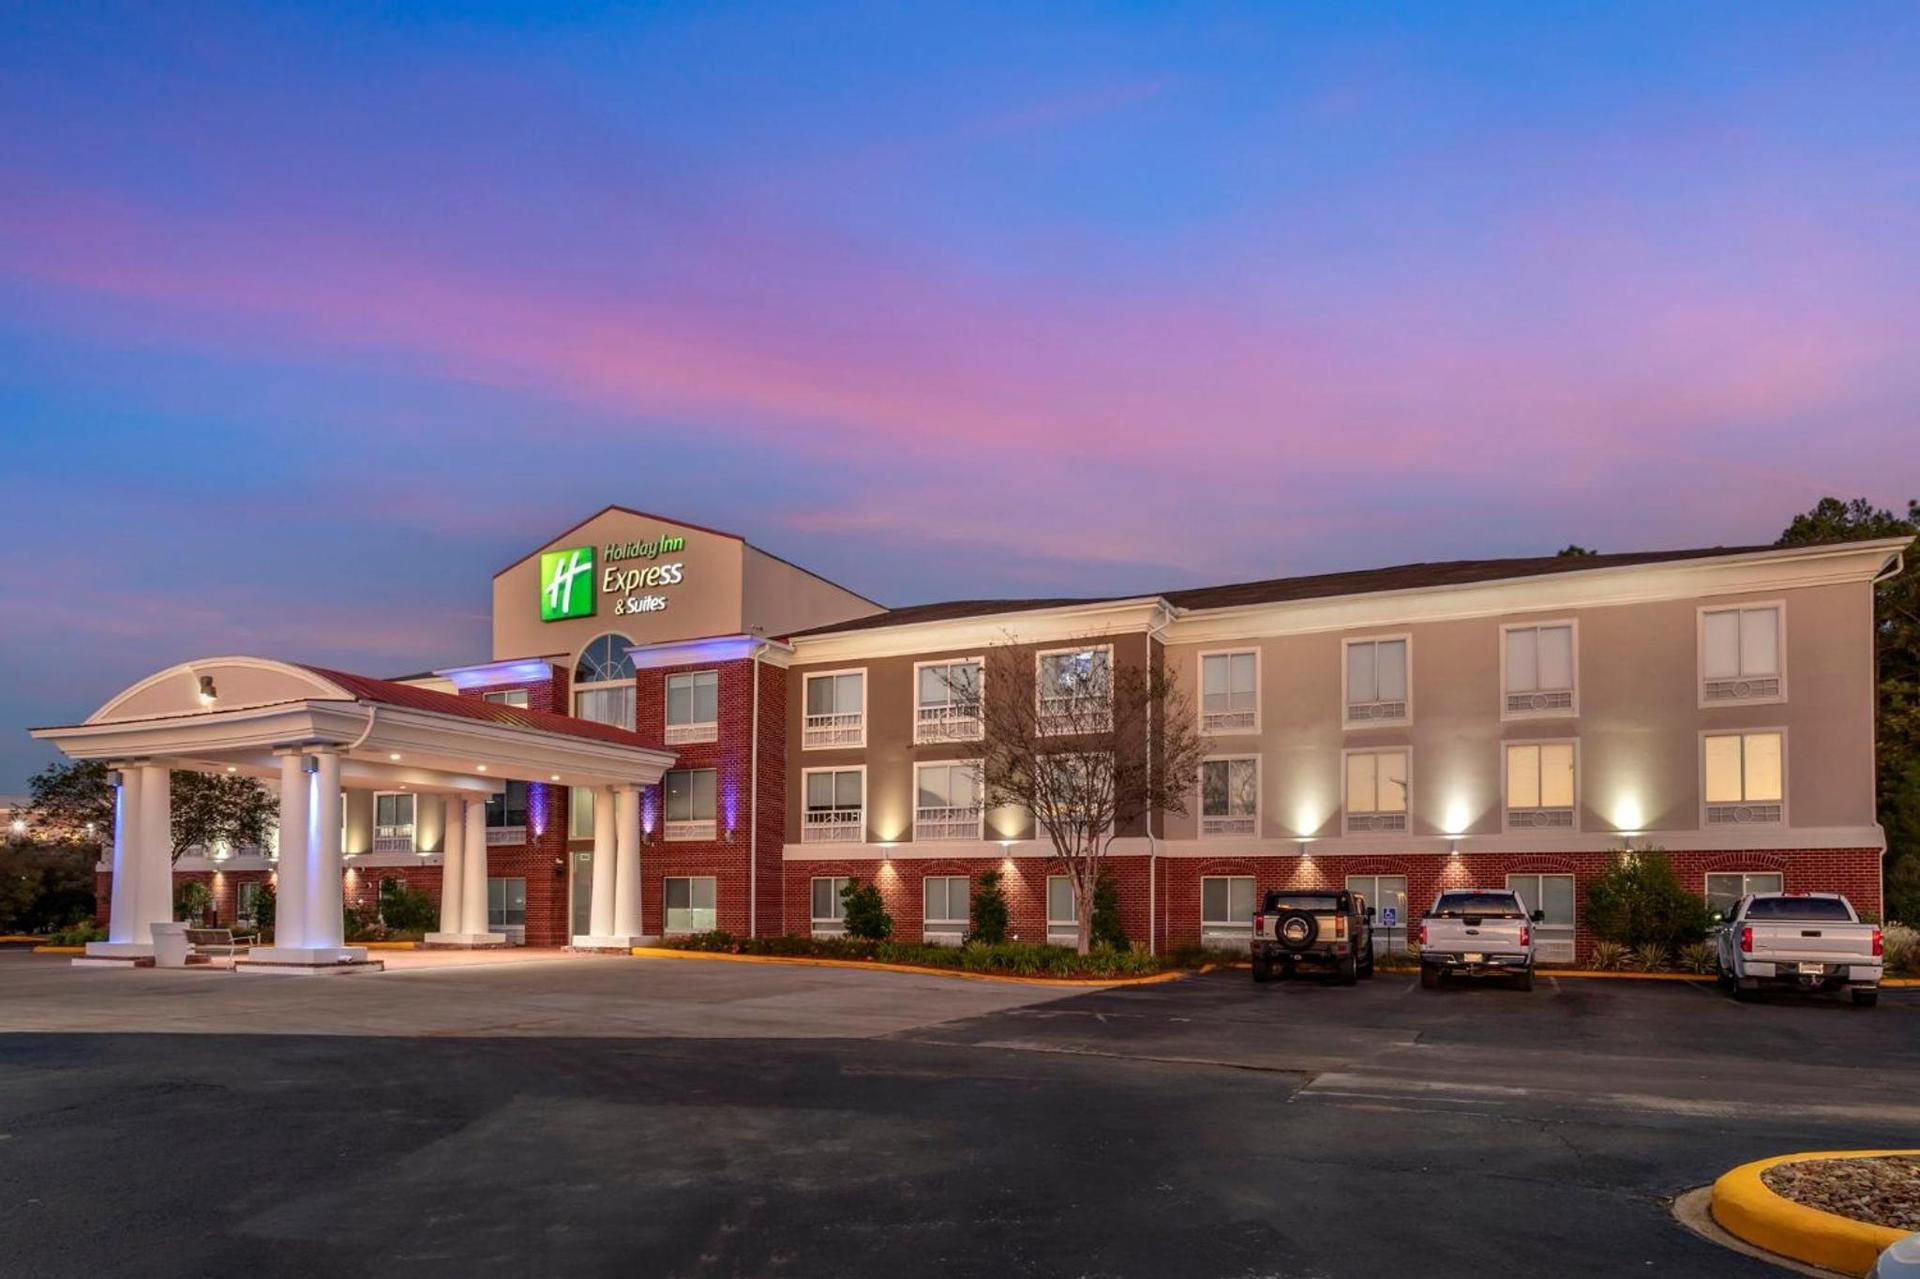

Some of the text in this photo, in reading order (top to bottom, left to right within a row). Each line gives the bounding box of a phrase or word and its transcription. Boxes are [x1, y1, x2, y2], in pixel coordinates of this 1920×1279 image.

[603, 534, 683, 560] Holiday Inn
[546, 551, 592, 613] H
[602, 563, 683, 596] Express
[615, 595, 666, 615] & Suites
